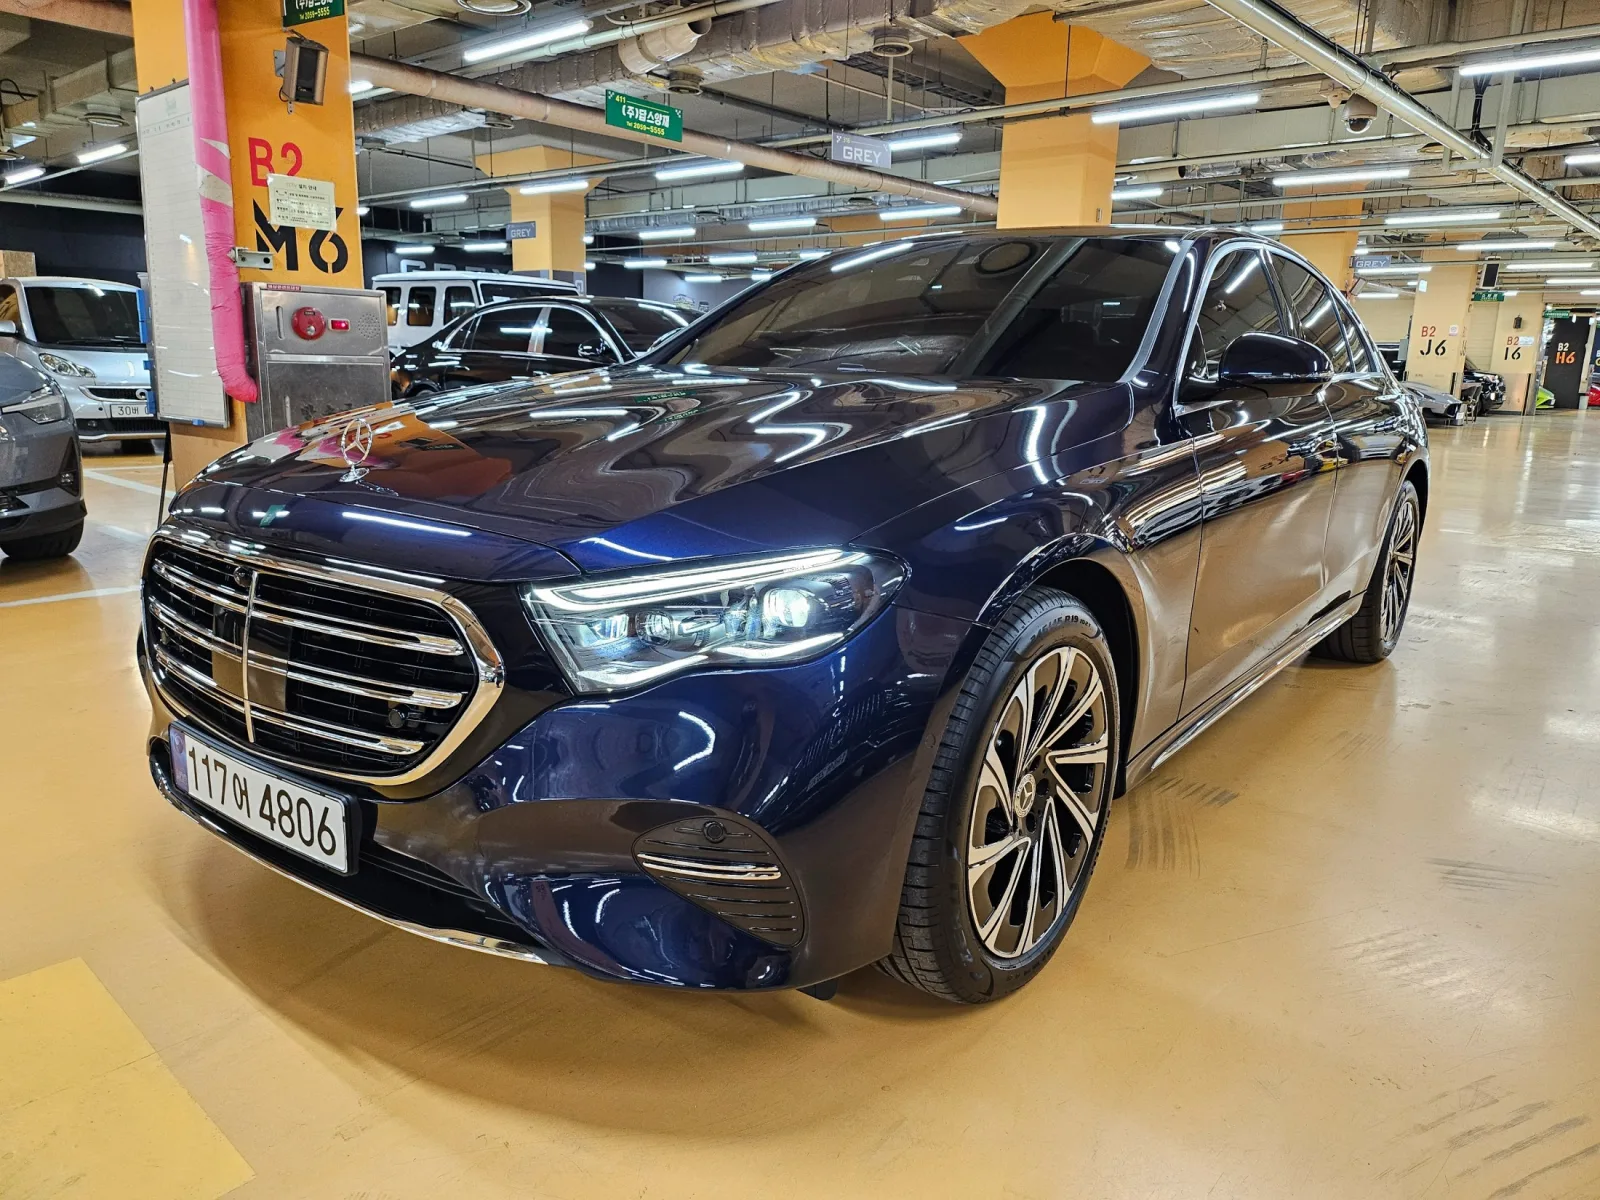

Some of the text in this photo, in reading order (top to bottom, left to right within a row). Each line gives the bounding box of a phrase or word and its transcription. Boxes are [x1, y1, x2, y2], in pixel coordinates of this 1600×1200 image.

[305, 6, 330, 20] 2059-5555
[615, 95, 626, 103] 411
[633, 122, 665, 136] 2059-5555
[843, 146, 882, 164] GREY
[248, 136, 303, 187] B2
[252, 198, 349, 274] M6
[510, 228, 531, 238] GREY
[1356, 260, 1387, 268] GREY
[1421, 326, 1436, 338] B2
[1507, 336, 1520, 346] B2
[1557, 342, 1569, 351] B2
[1420, 339, 1447, 356] J6
[1555, 352, 1576, 364] H6
[1064, 615, 1079, 623] R19
[189, 746, 336, 856] 117어 4806
